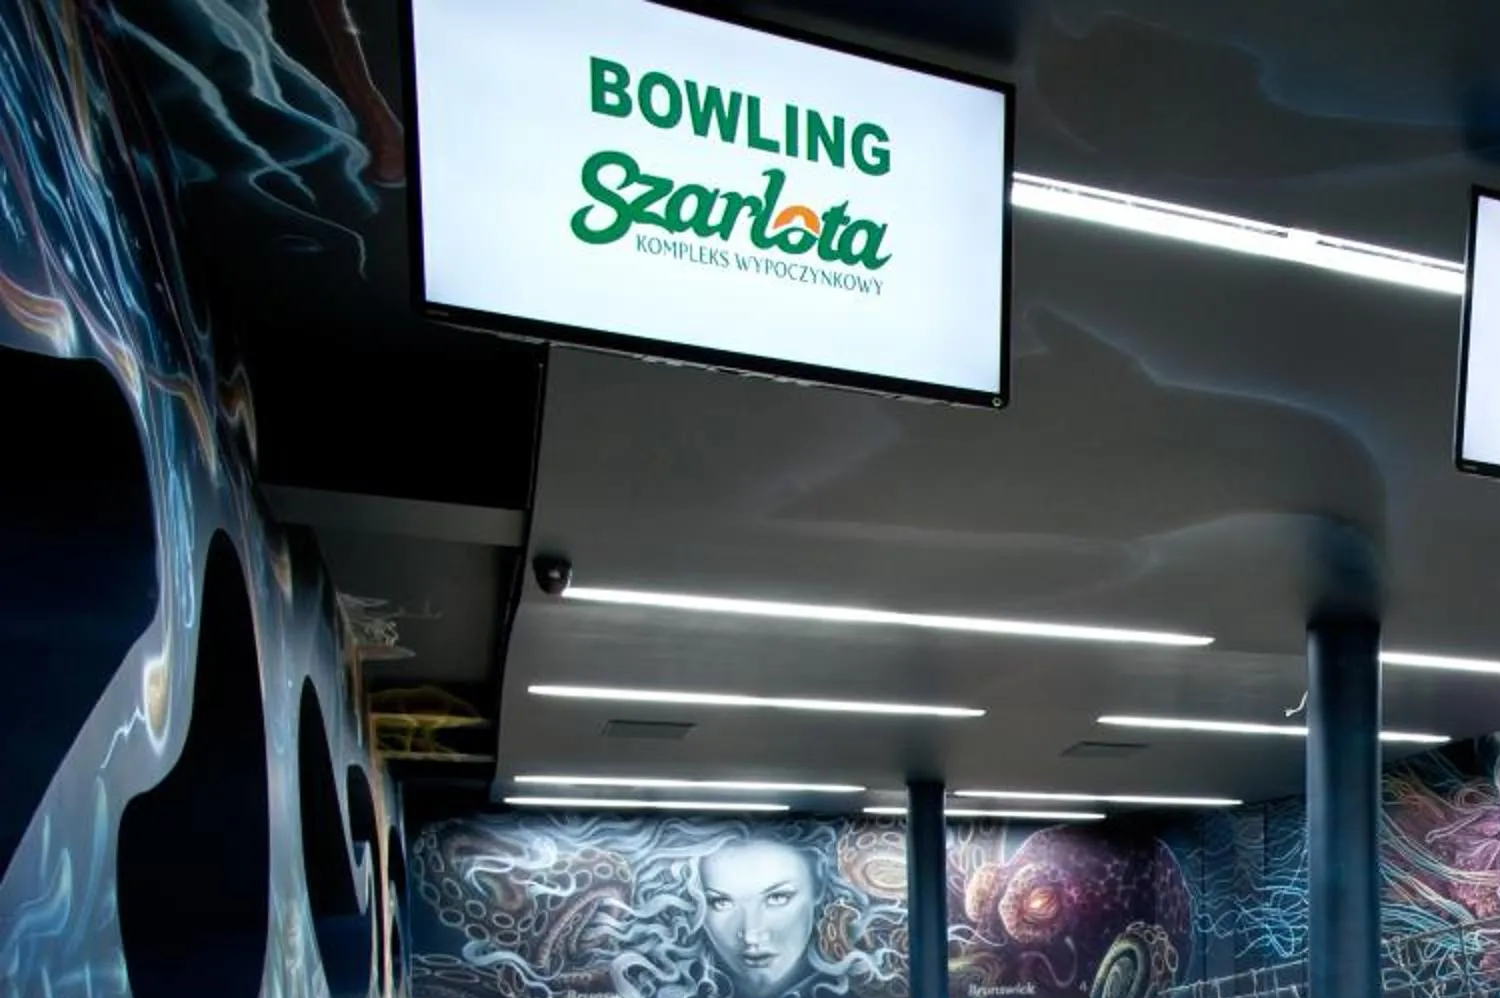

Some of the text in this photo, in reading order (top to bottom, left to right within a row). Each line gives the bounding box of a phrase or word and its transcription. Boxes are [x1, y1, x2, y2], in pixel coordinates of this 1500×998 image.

[588, 55, 892, 177] BOWLING
[569, 149, 892, 271] Szarlota
[635, 233, 884, 297] KOMPLEKS WYPOCZYNKOWY
[968, 981, 1036, 997] Brunswick
